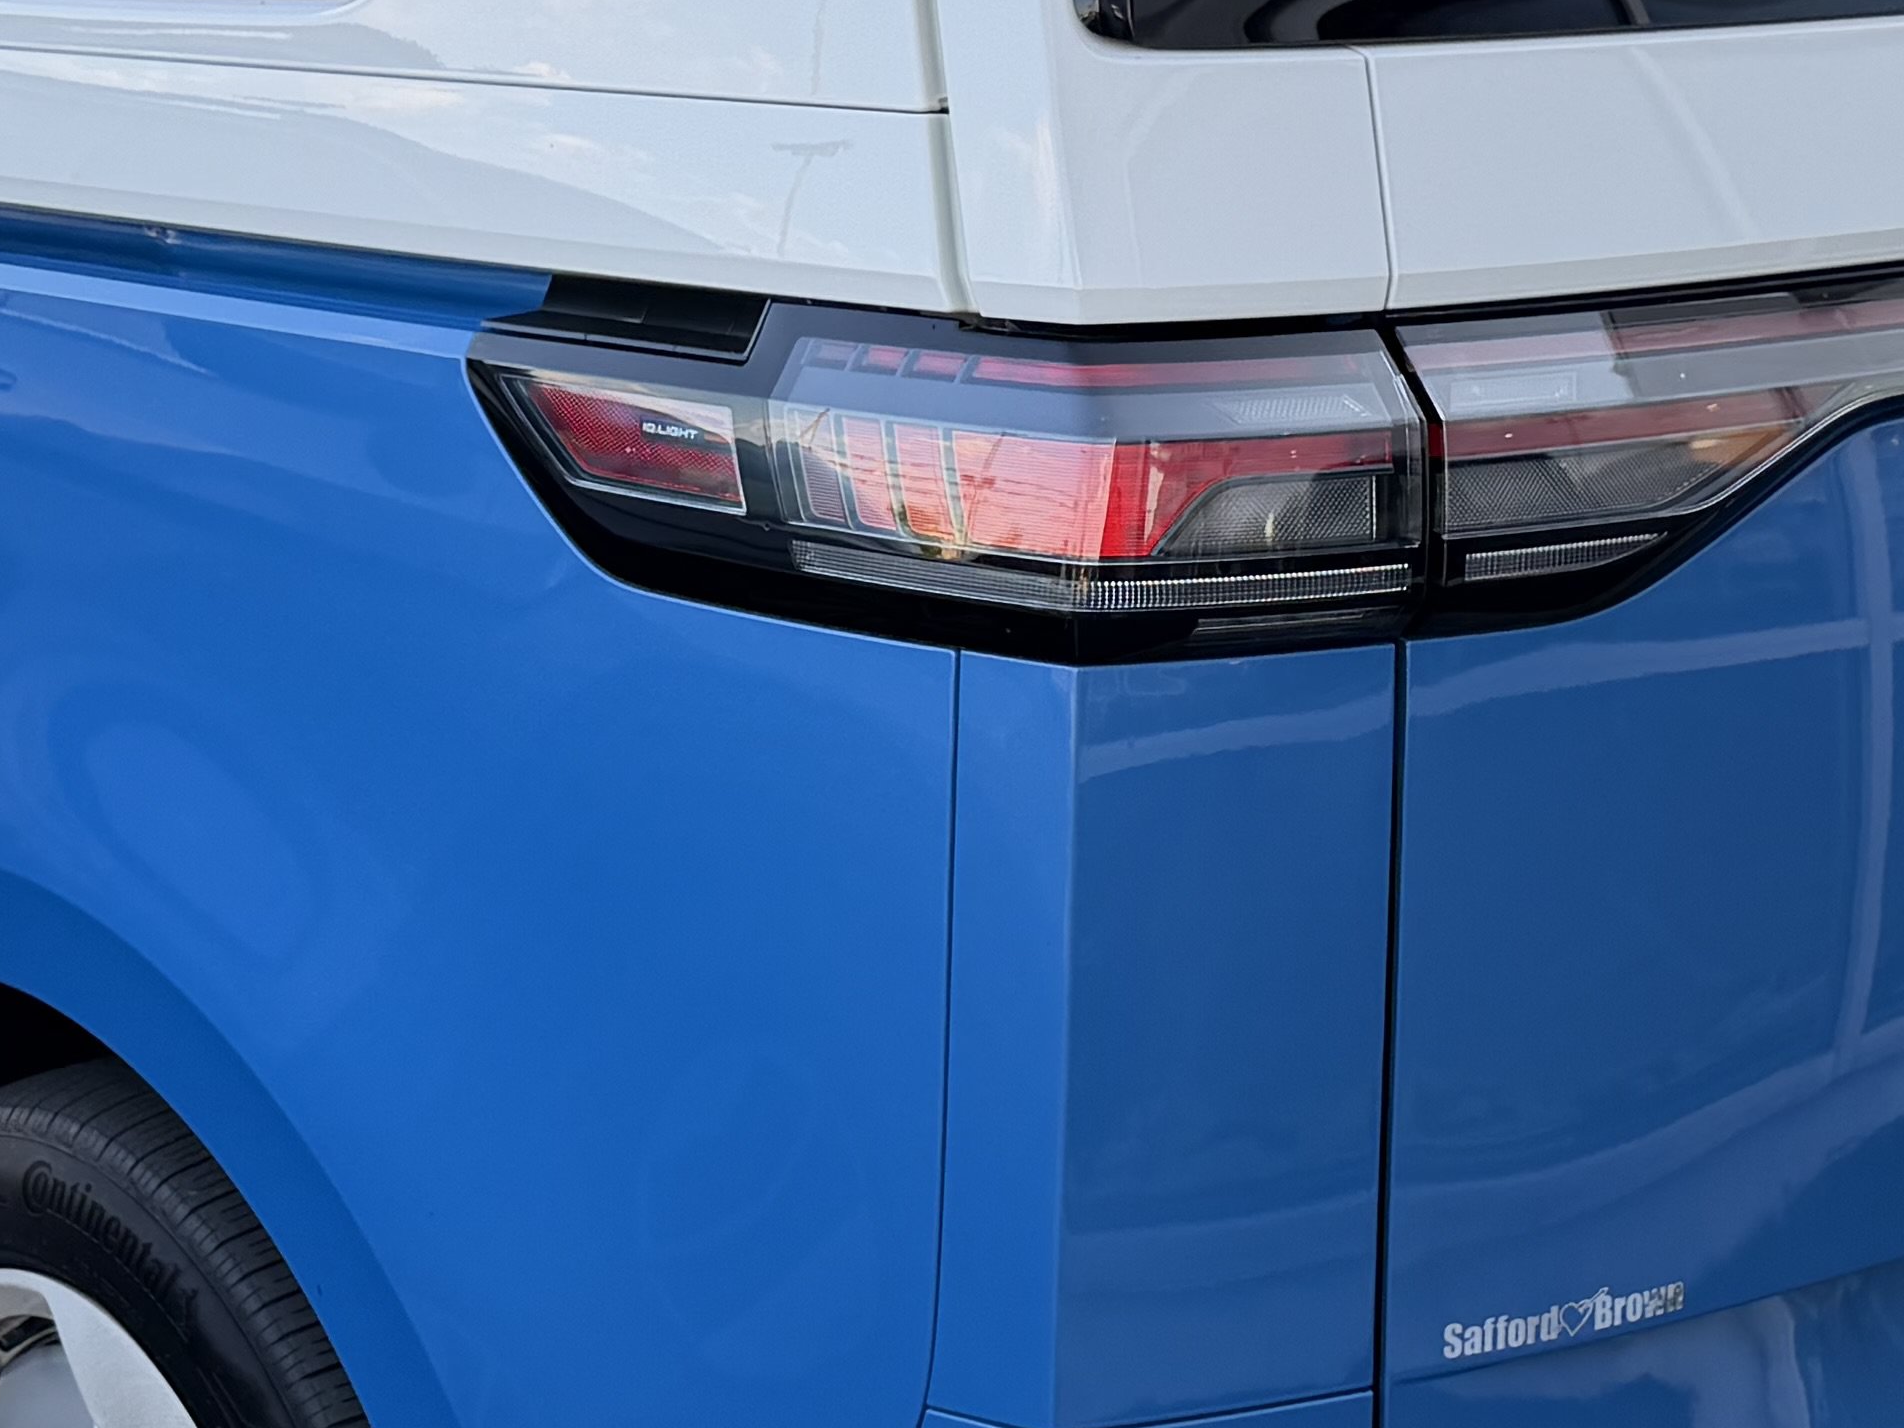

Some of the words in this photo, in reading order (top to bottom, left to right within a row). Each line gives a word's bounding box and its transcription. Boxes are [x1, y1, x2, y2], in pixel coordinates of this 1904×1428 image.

[22, 1159, 185, 1302] Continental
[1443, 1306, 1561, 1359] Safford
[1594, 1281, 1684, 1331] Brown
